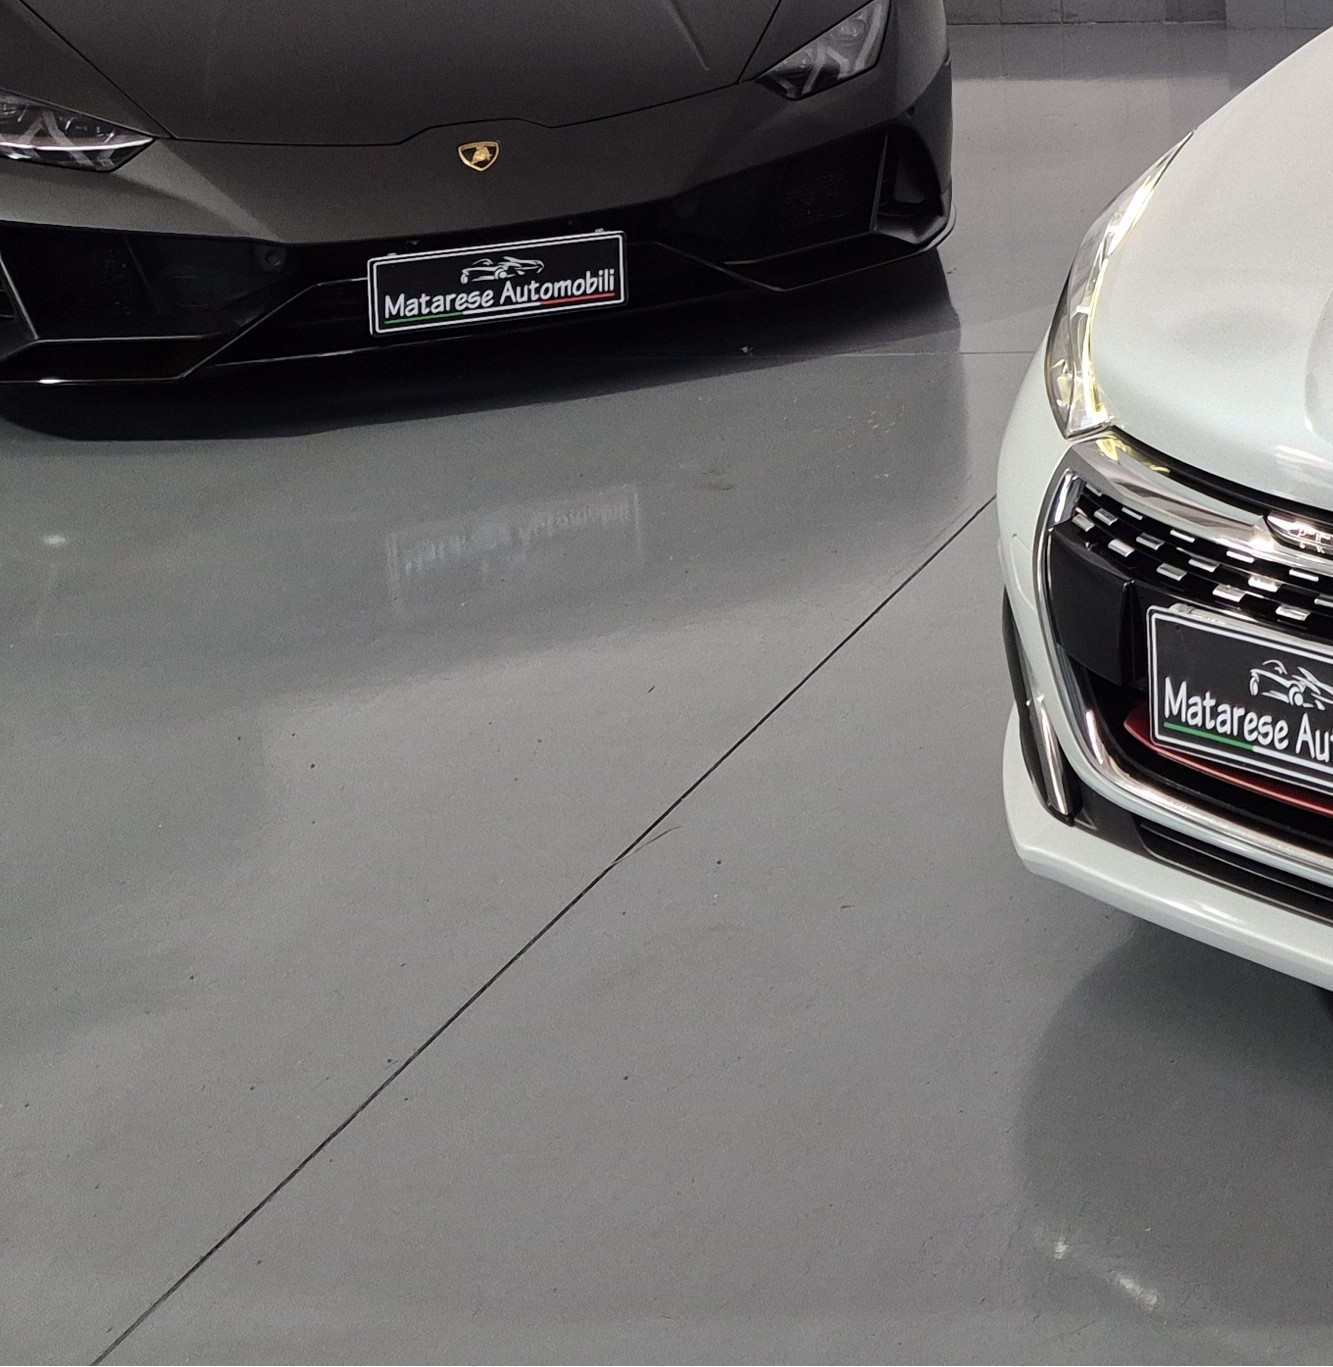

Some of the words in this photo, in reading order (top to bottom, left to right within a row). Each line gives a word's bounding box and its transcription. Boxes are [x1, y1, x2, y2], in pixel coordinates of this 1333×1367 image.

[384, 288, 495, 319] Matarese
[499, 268, 615, 305] Automobili
[1163, 676, 1290, 751] Matarese
